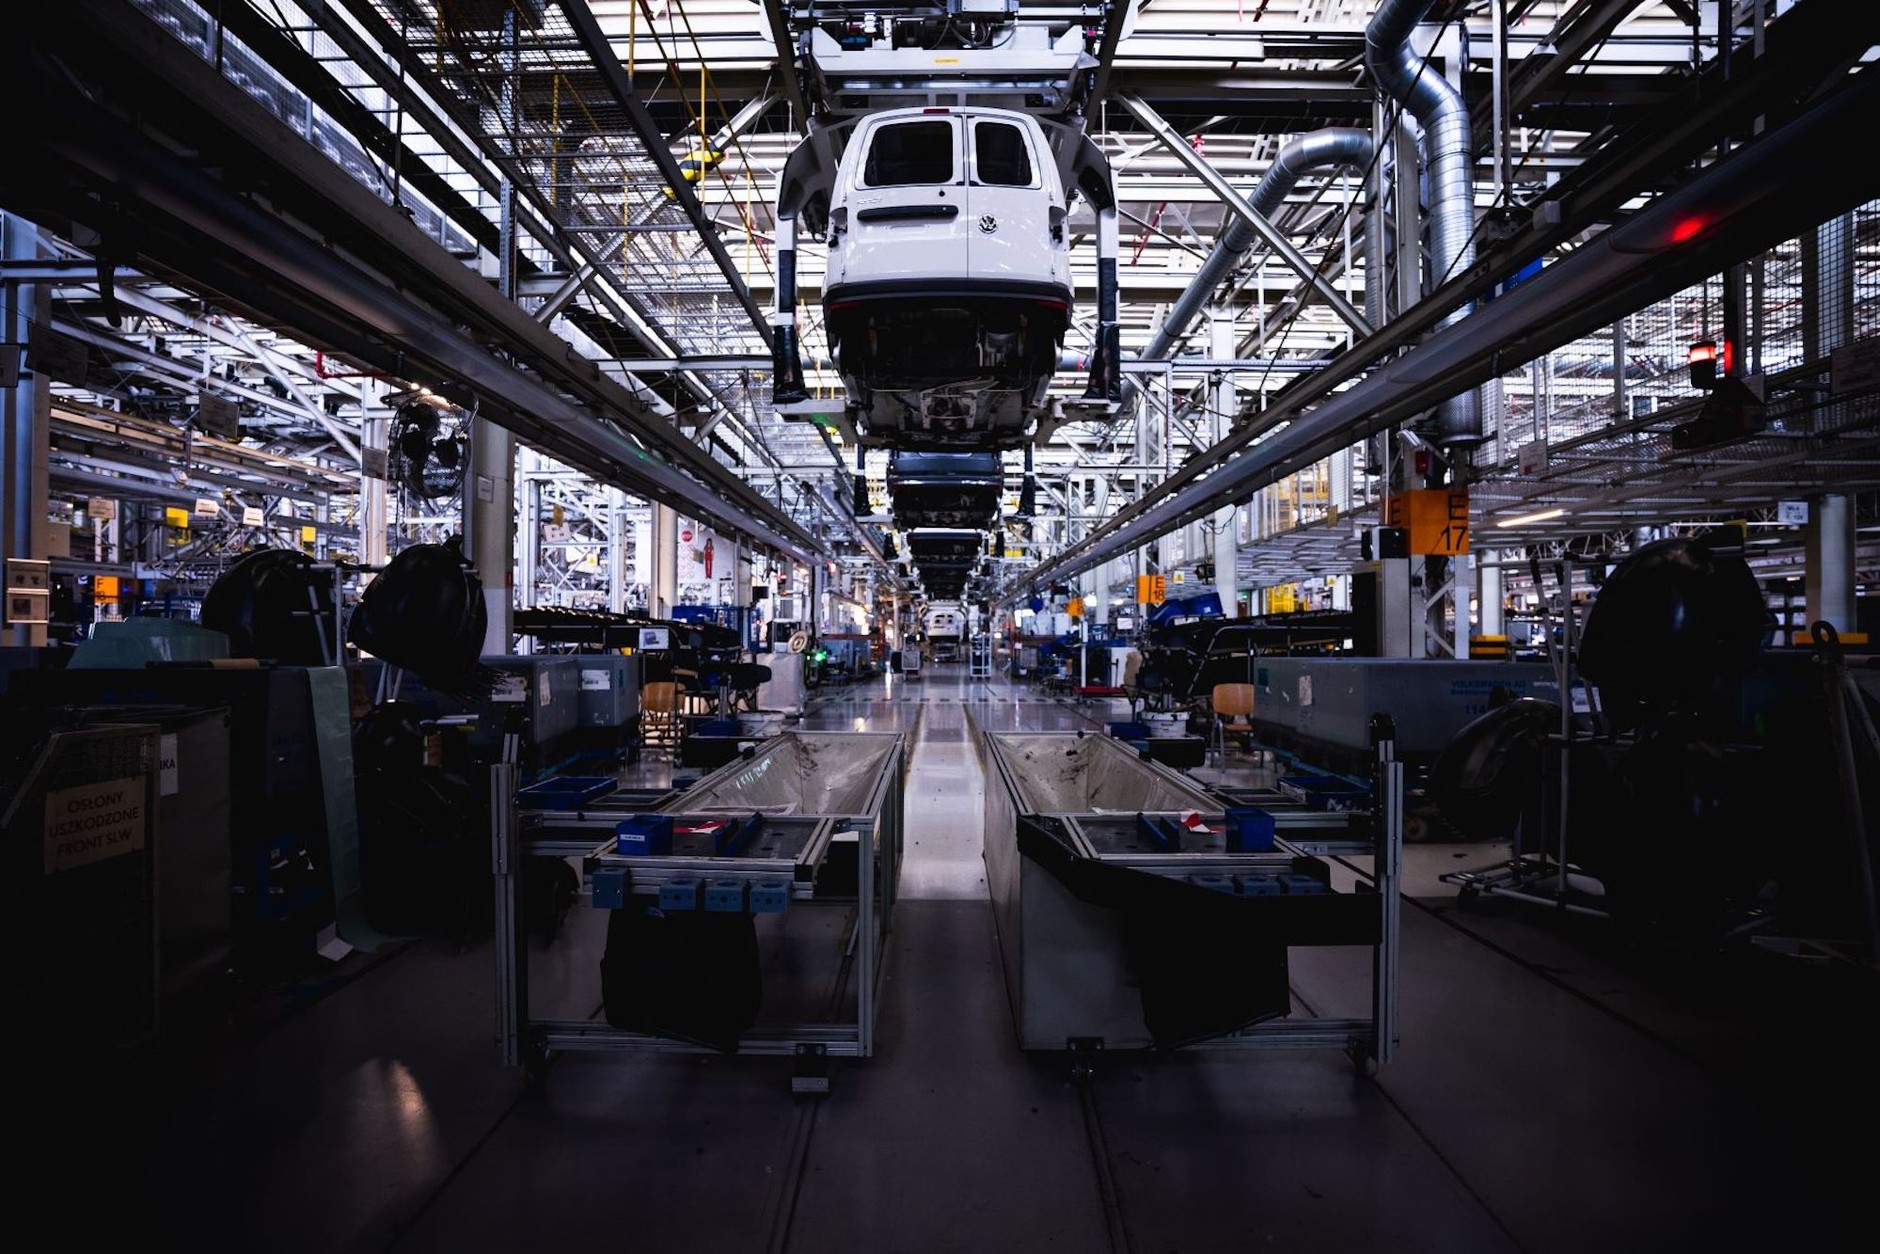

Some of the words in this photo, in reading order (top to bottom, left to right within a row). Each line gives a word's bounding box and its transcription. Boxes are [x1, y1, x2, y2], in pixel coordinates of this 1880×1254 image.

[1448, 493, 1467, 520] E
[1440, 526, 1468, 551] 17
[1155, 576, 1165, 589] E
[1152, 589, 1165, 602] 18
[67, 791, 124, 814] OSŁONY
[48, 806, 140, 838] USZKODZONE
[56, 835, 104, 858] FRONT
